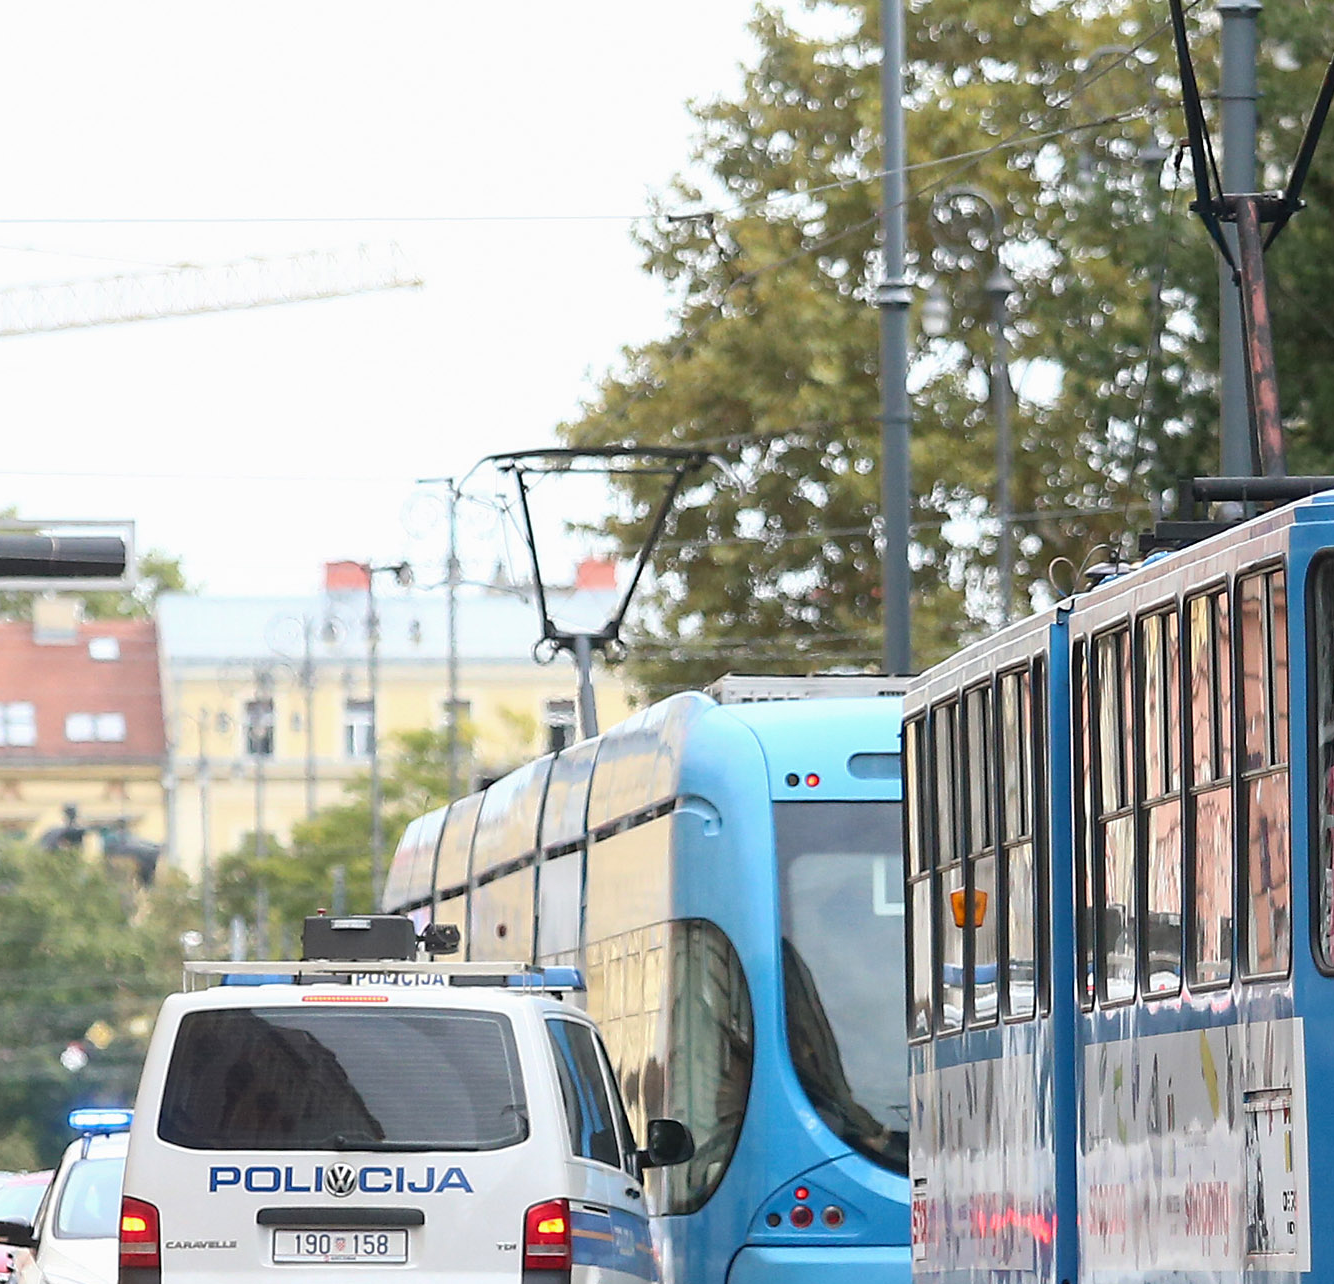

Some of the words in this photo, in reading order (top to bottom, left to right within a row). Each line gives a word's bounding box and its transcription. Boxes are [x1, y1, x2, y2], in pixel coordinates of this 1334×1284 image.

[209, 1166, 474, 1194] POLICIJA
[165, 1240, 237, 1249] CARAVELLE
[295, 1233, 331, 1255] 190
[354, 1233, 388, 1255] 158
[496, 1243, 517, 1251] TDI
